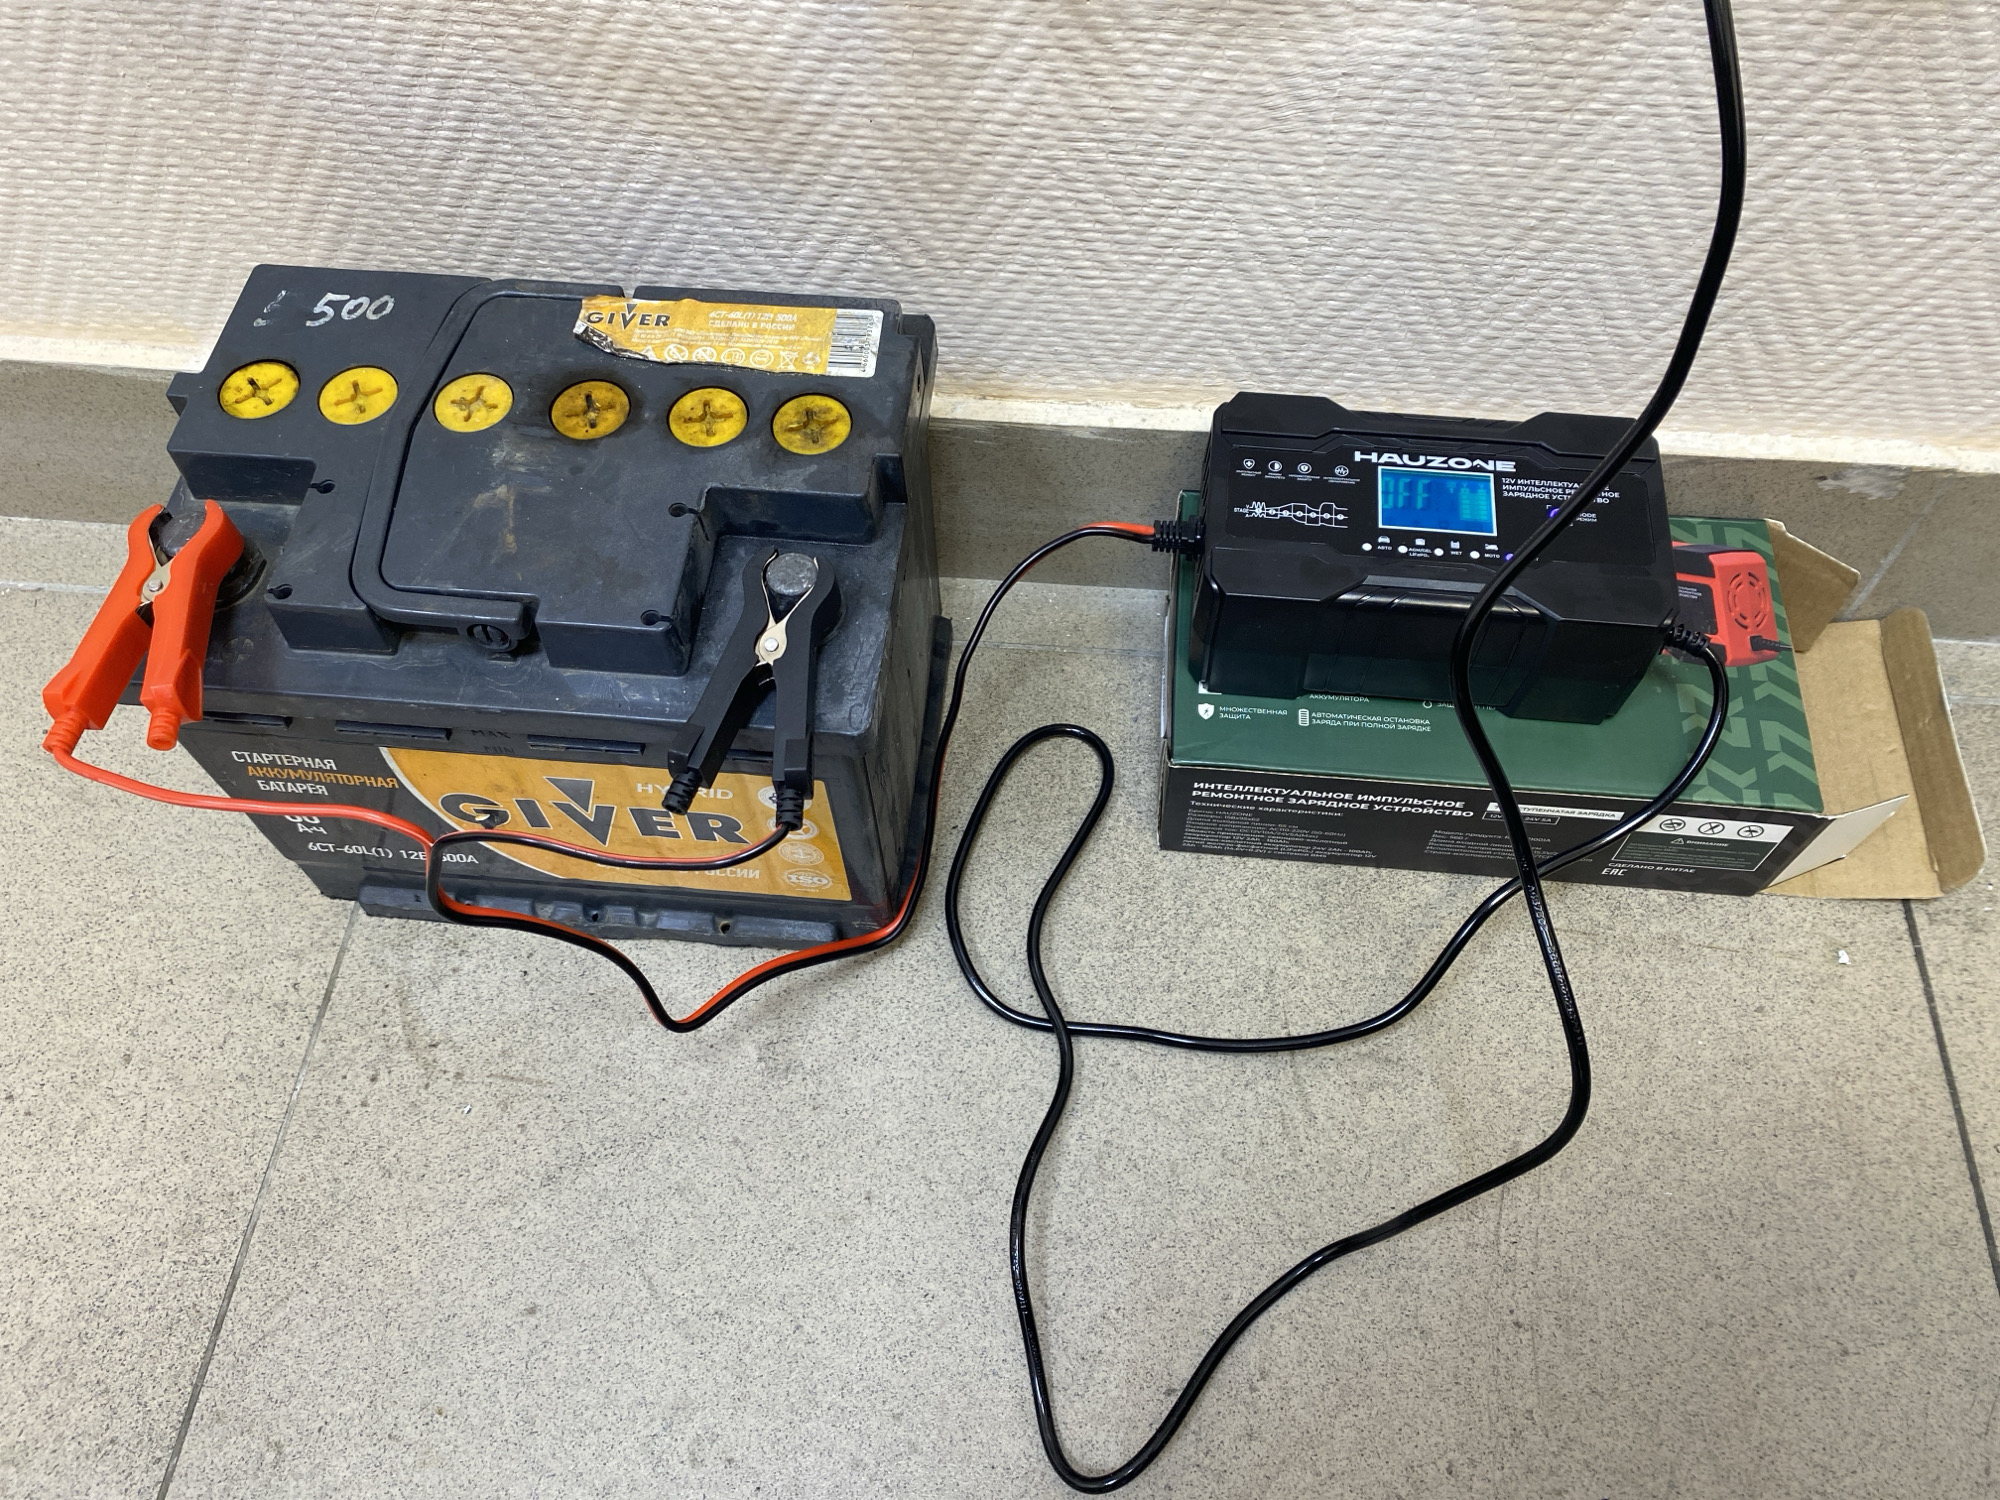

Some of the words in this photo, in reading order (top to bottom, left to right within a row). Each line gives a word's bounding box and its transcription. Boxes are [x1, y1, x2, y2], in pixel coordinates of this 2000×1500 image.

[306, 292, 395, 326] 500
[587, 304, 671, 330] GIVER
[709, 319, 749, 328] СДЕЛАНО
[760, 322, 796, 331] РОССИИ
[1354, 450, 1517, 472] HAUZONE
[1502, 484, 1564, 494] ИМПУЛЬСНОЕ
[1565, 488, 1621, 498] РЕНОЕ
[1518, 479, 1610, 491] ИНТЕЛЛЕКТУАЕ
[1502, 490, 1550, 499] ЗАРЯДНОЕ
[1309, 693, 1369, 702] АККУМУЛЯТОРА
[1219, 706, 1288, 716] МНОЖЕСТВЕННАЯ
[1311, 712, 1381, 722] АВТОМАТИЧЕСКАЯ
[1383, 716, 1430, 725] ОСТАНОВКА
[1311, 718, 1341, 726] ЗАРЯДА
[1361, 721, 1395, 730] ПОЛНОЙ
[1397, 724, 1431, 732] ЗАРЯДКЕ
[231, 750, 337, 771] СТАРТЕРНАЯ
[248, 766, 399, 789] АККУМУЛЯТОРНАЯ
[257, 780, 328, 796] БАТАРЕЯ
[637, 783, 733, 799] HYRID
[1193, 782, 1354, 800] ИНТЕЛЛЕКТУАЛЬНОЕ
[1357, 794, 1465, 809] ИМПУЛЬСНОЕ
[1190, 801, 1255, 811] Технические
[1258, 807, 1344, 818] характеристики:
[1191, 790, 1283, 804] РЕМОНТНОЕ
[1287, 797, 1369, 811] ЗАРЯДНОЕ
[1372, 801, 1474, 818] УСТРОЙСТВО
[440, 776, 751, 847] GIVER
[1576, 811, 1616, 819] ЗАРЯДКА
[1686, 839, 1729, 848] ВНИМАНИЕ
[704, 867, 760, 879] ОССИИ
[1601, 867, 1628, 877] EAC
[1608, 862, 1657, 870] СДЕЛАНО
[1664, 866, 1696, 874] КИТАЕ
[787, 873, 828, 885] ISO
